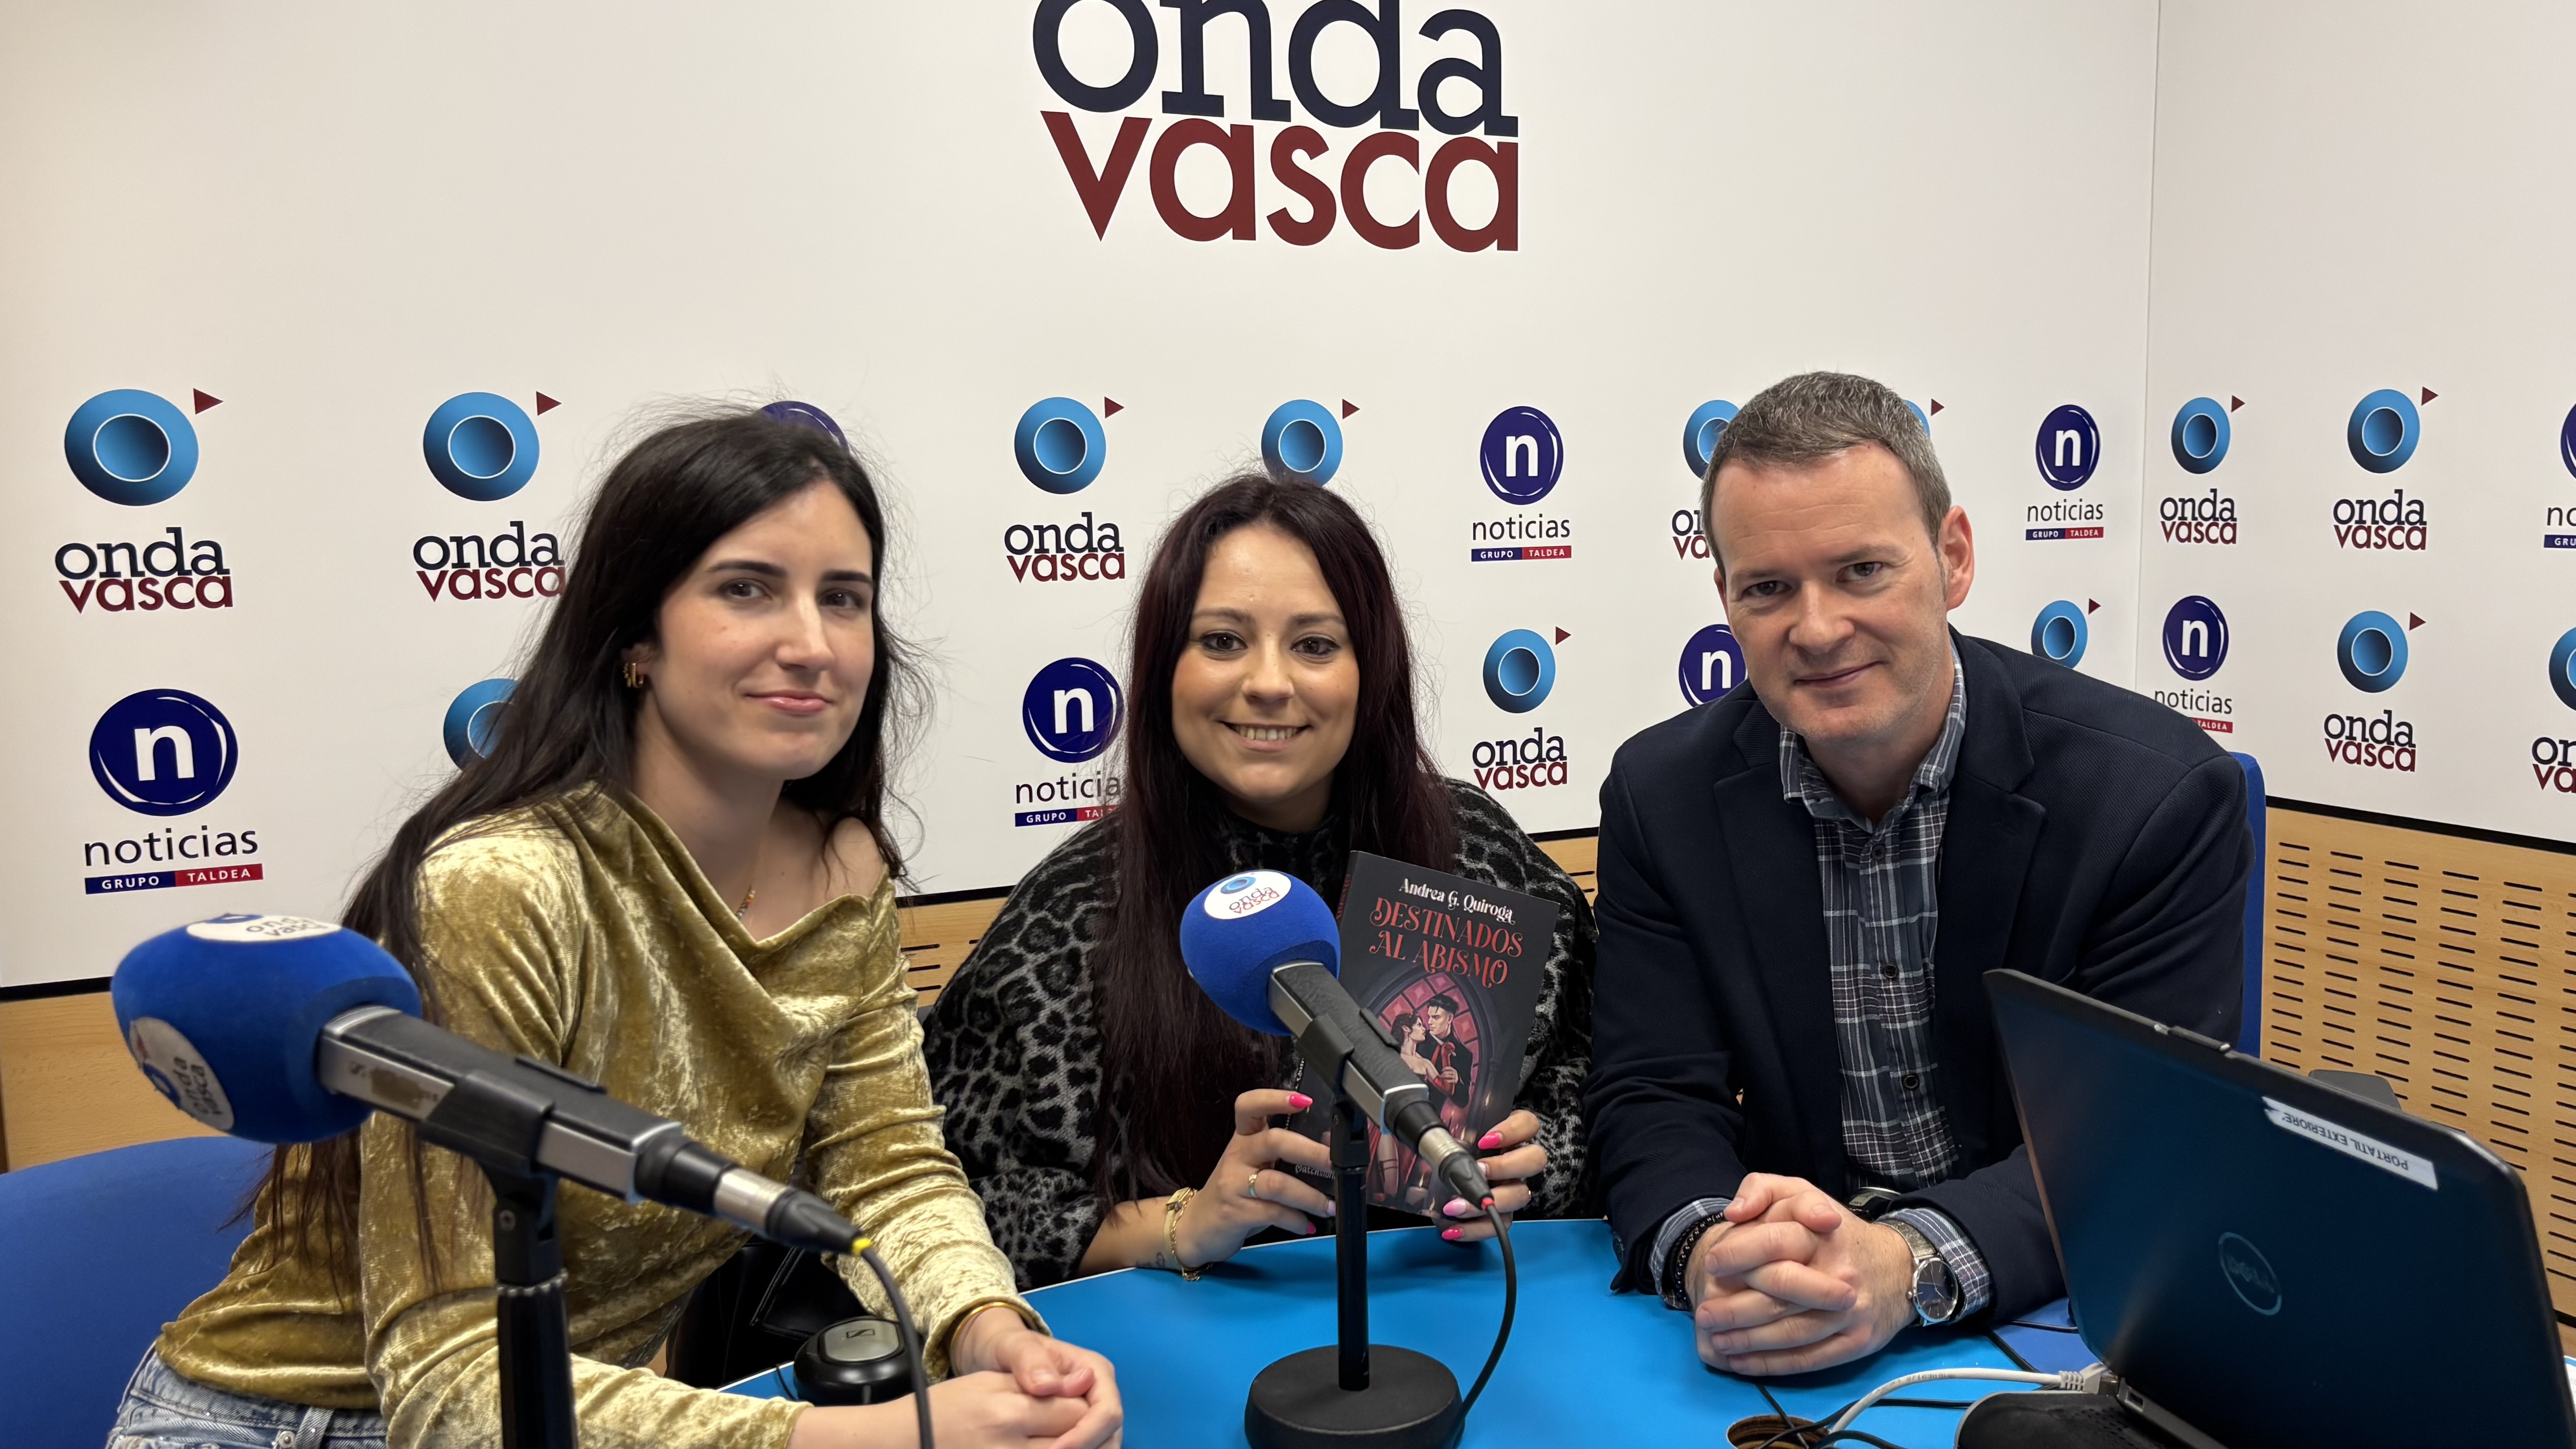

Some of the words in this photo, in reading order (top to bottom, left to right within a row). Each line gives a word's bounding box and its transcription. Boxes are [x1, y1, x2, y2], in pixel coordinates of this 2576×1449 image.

[1033, 0, 1518, 138] onda
[1040, 111, 1518, 253] vasca
[2027, 498, 2103, 522] noticias
[2160, 488, 2237, 526] onda
[2333, 489, 2427, 526] onda
[1004, 512, 1124, 555] onda
[1473, 513, 1570, 541] noticias
[2071, 529, 2098, 537] TALDEA
[2160, 521, 2237, 545] vasca
[2333, 524, 2427, 551] vasca
[2554, 537, 2576, 546] GRU
[55, 527, 230, 580] onda
[413, 520, 565, 570] onda
[1480, 550, 1513, 559] GRUPO
[1529, 549, 1565, 557] TALDEA
[416, 566, 566, 602] vasca
[1006, 552, 1125, 583] vasca
[58, 575, 233, 615] vasca
[2155, 688, 2232, 715] noticias
[2324, 709, 2416, 748] onda
[1472, 727, 1567, 768] onda
[2324, 739, 2416, 772] vasca
[1015, 770, 1121, 804] noticia
[1474, 761, 1568, 790] vasca
[1026, 812, 1066, 823] GRUPO
[84, 824, 259, 866] noticias
[101, 876, 160, 890] GRUPO
[187, 868, 252, 883] TALDEA
[1229, 887, 1273, 911] onda
[1233, 891, 1280, 914] vasca
[1399, 878, 1445, 903] Andrea
[1463, 894, 1516, 925] Quiroga
[1369, 897, 1523, 958] DESTINADOS
[1369, 930, 1406, 961] AL
[1412, 939, 1509, 989] ABISMO
[2350, 1137, 2409, 1171] PORTATIL
